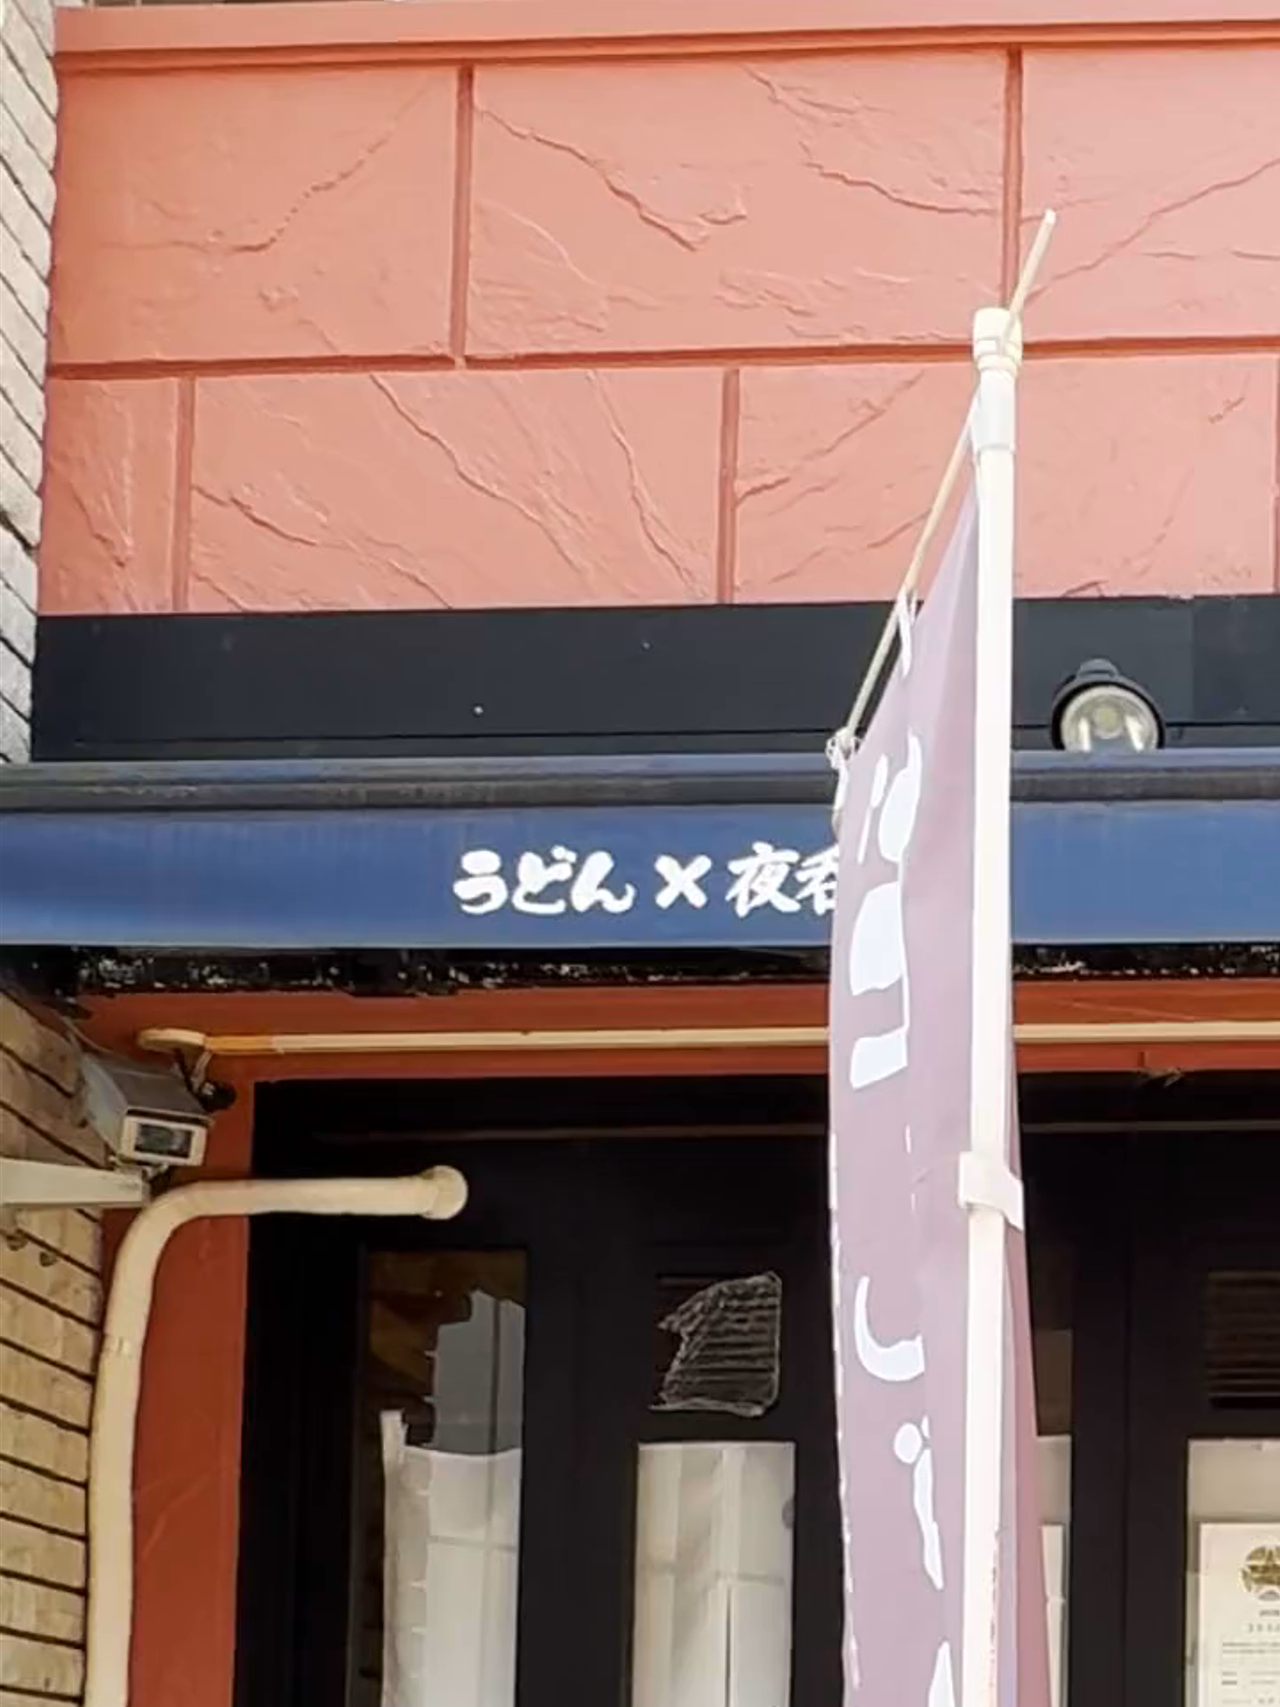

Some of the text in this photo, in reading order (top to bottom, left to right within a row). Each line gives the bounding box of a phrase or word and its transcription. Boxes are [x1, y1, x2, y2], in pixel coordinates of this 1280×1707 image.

[452, 841, 839, 919] うどん×夜呑
